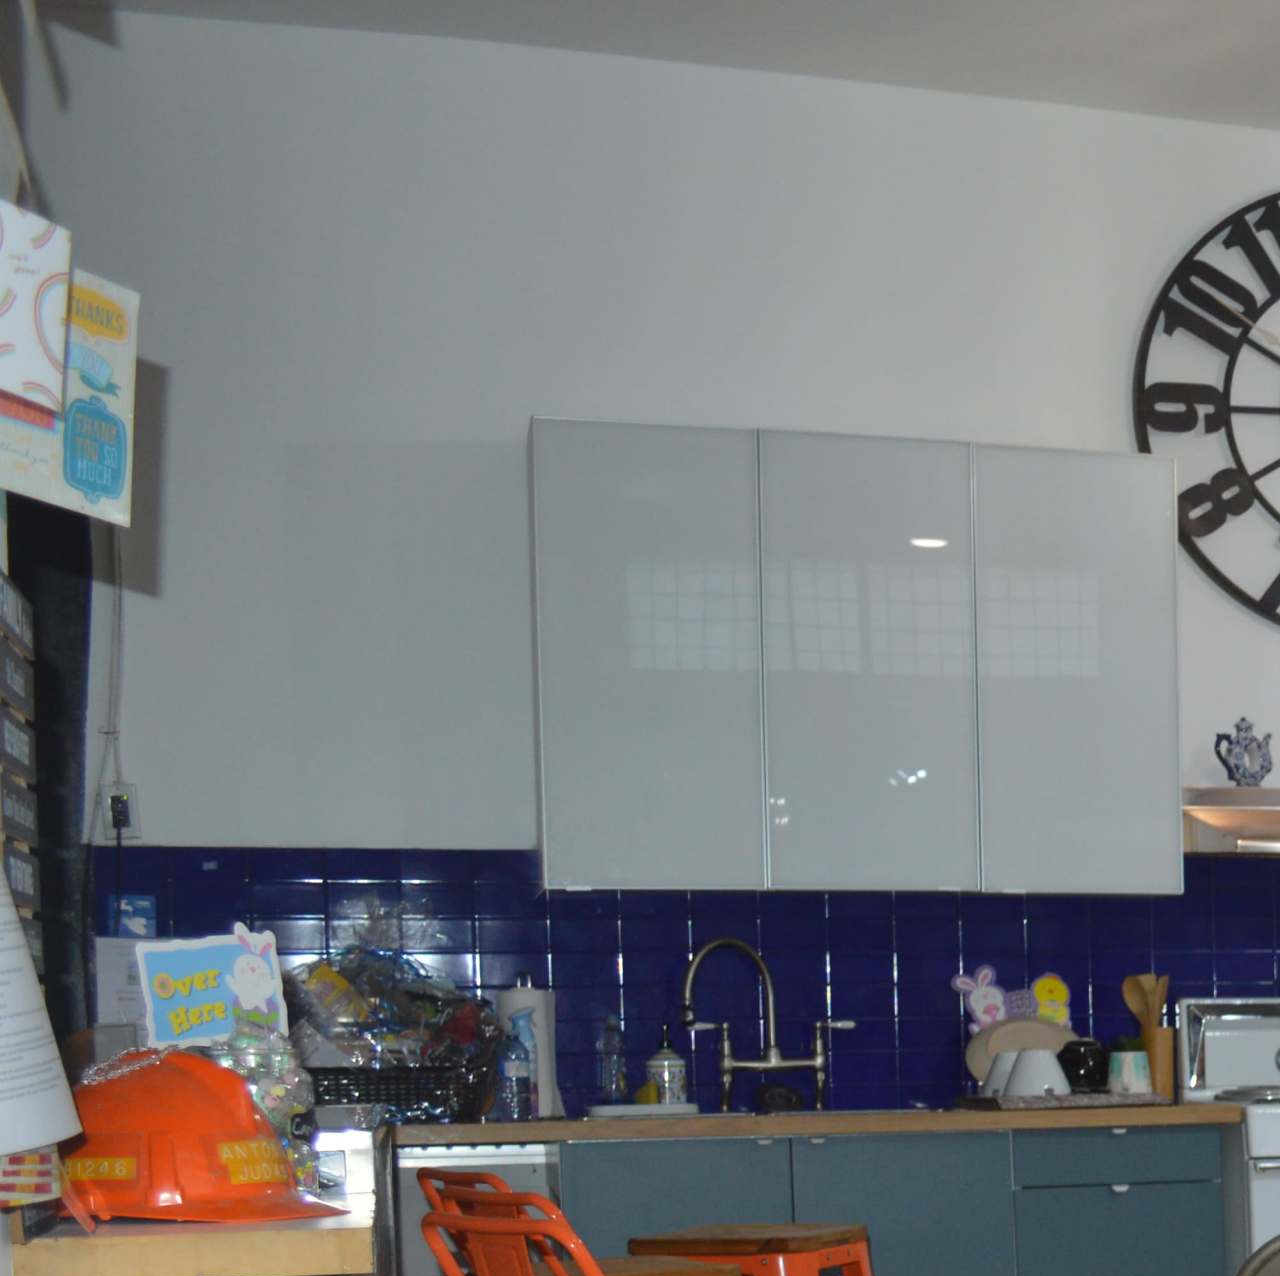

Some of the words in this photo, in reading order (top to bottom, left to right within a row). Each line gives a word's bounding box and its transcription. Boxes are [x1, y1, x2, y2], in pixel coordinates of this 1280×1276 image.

[1163, 258, 1259, 357] 10
[1144, 381, 1226, 434] 9
[78, 457, 112, 486] MUCH
[104, 444, 118, 468] SO
[1178, 467, 1256, 538] 8
[154, 968, 221, 1000] Over
[169, 1001, 227, 1037] Here
